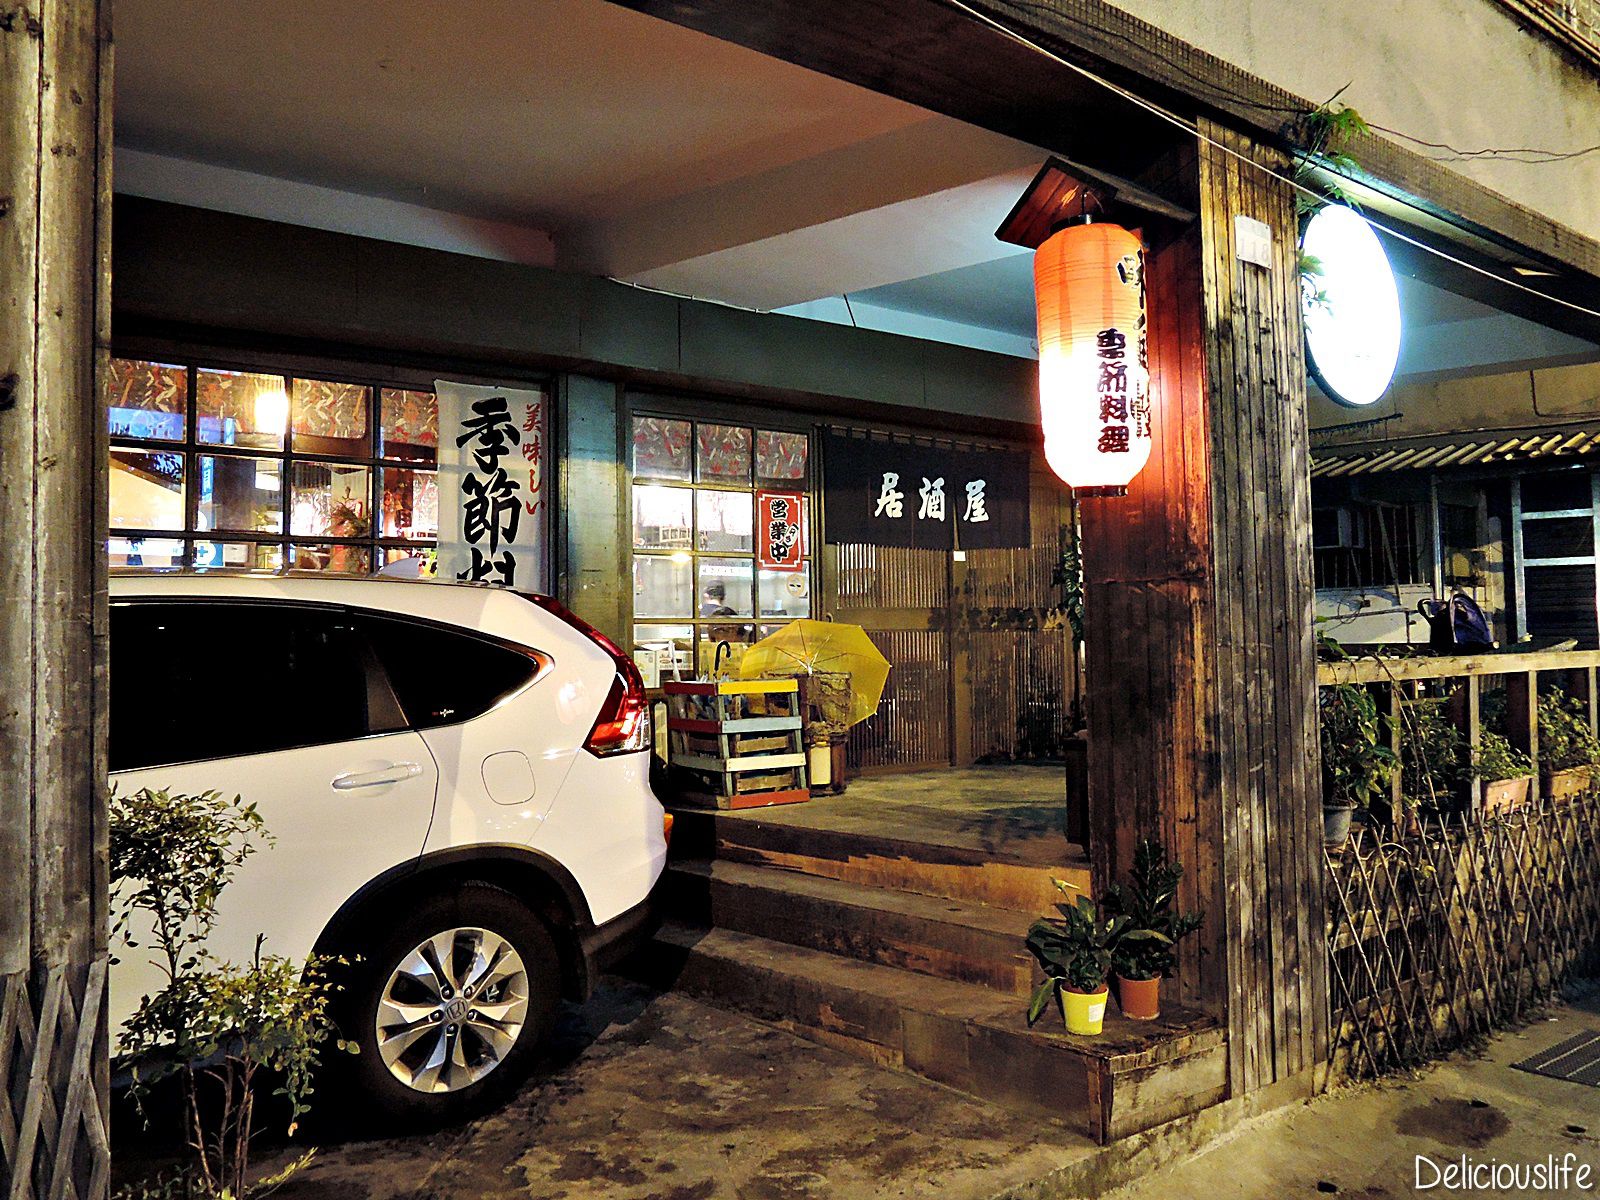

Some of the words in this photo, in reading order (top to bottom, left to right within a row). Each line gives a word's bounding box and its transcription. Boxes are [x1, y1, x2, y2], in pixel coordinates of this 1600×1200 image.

[522, 403, 545, 515] 美味しい
[874, 472, 990, 523] 居酒屋
[770, 499, 789, 562] 営業中
